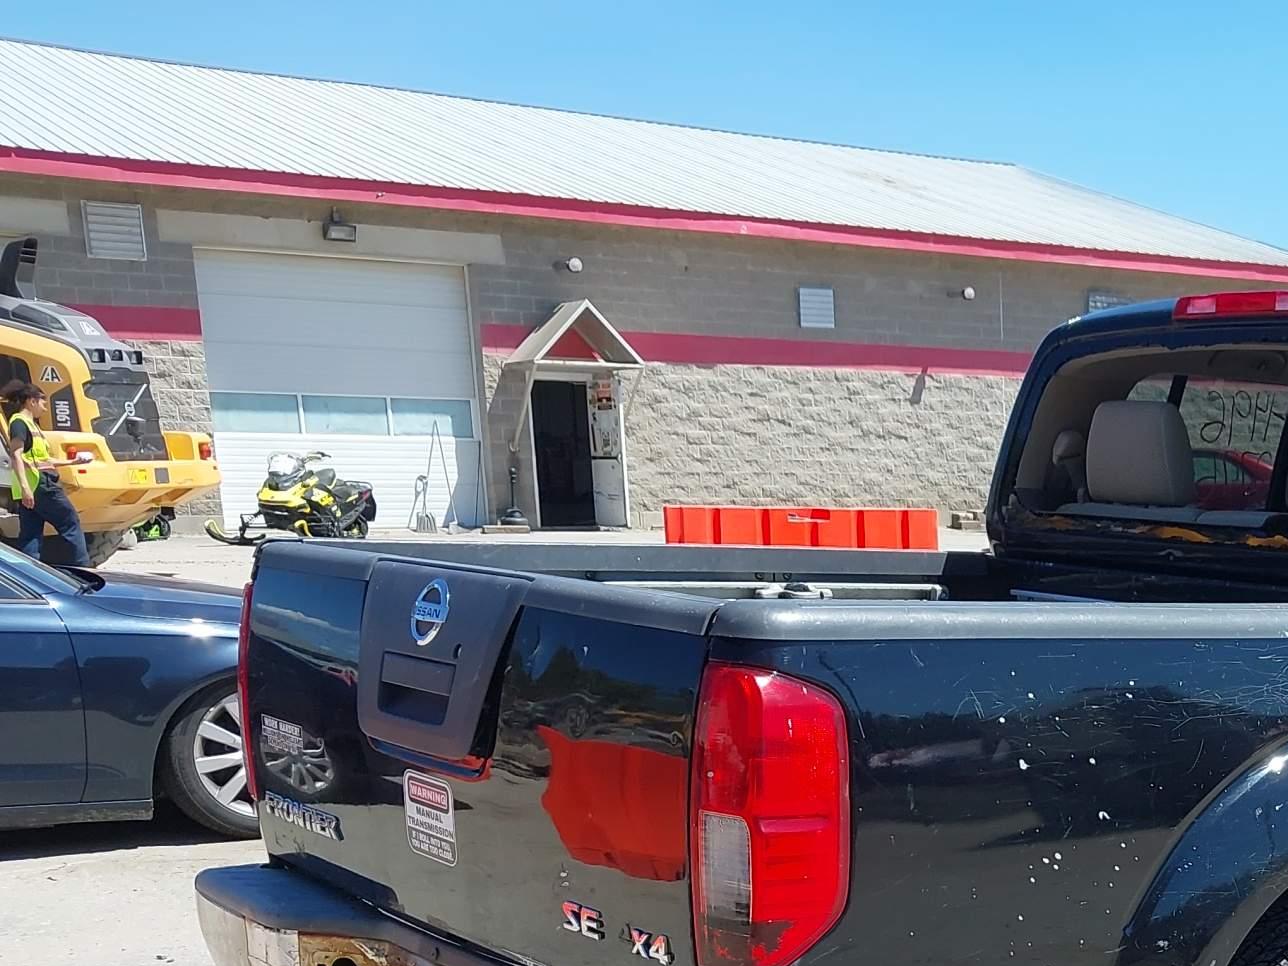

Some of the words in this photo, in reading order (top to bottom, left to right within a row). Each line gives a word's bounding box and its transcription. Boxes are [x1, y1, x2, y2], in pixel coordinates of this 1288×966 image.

[54, 400, 71, 427] L90H
[410, 782, 447, 806] WARNING
[265, 790, 341, 840] FRONTIER
[416, 805, 443, 824] MANUAL
[408, 815, 454, 841] TRANSMISSION
[562, 900, 605, 940] SE
